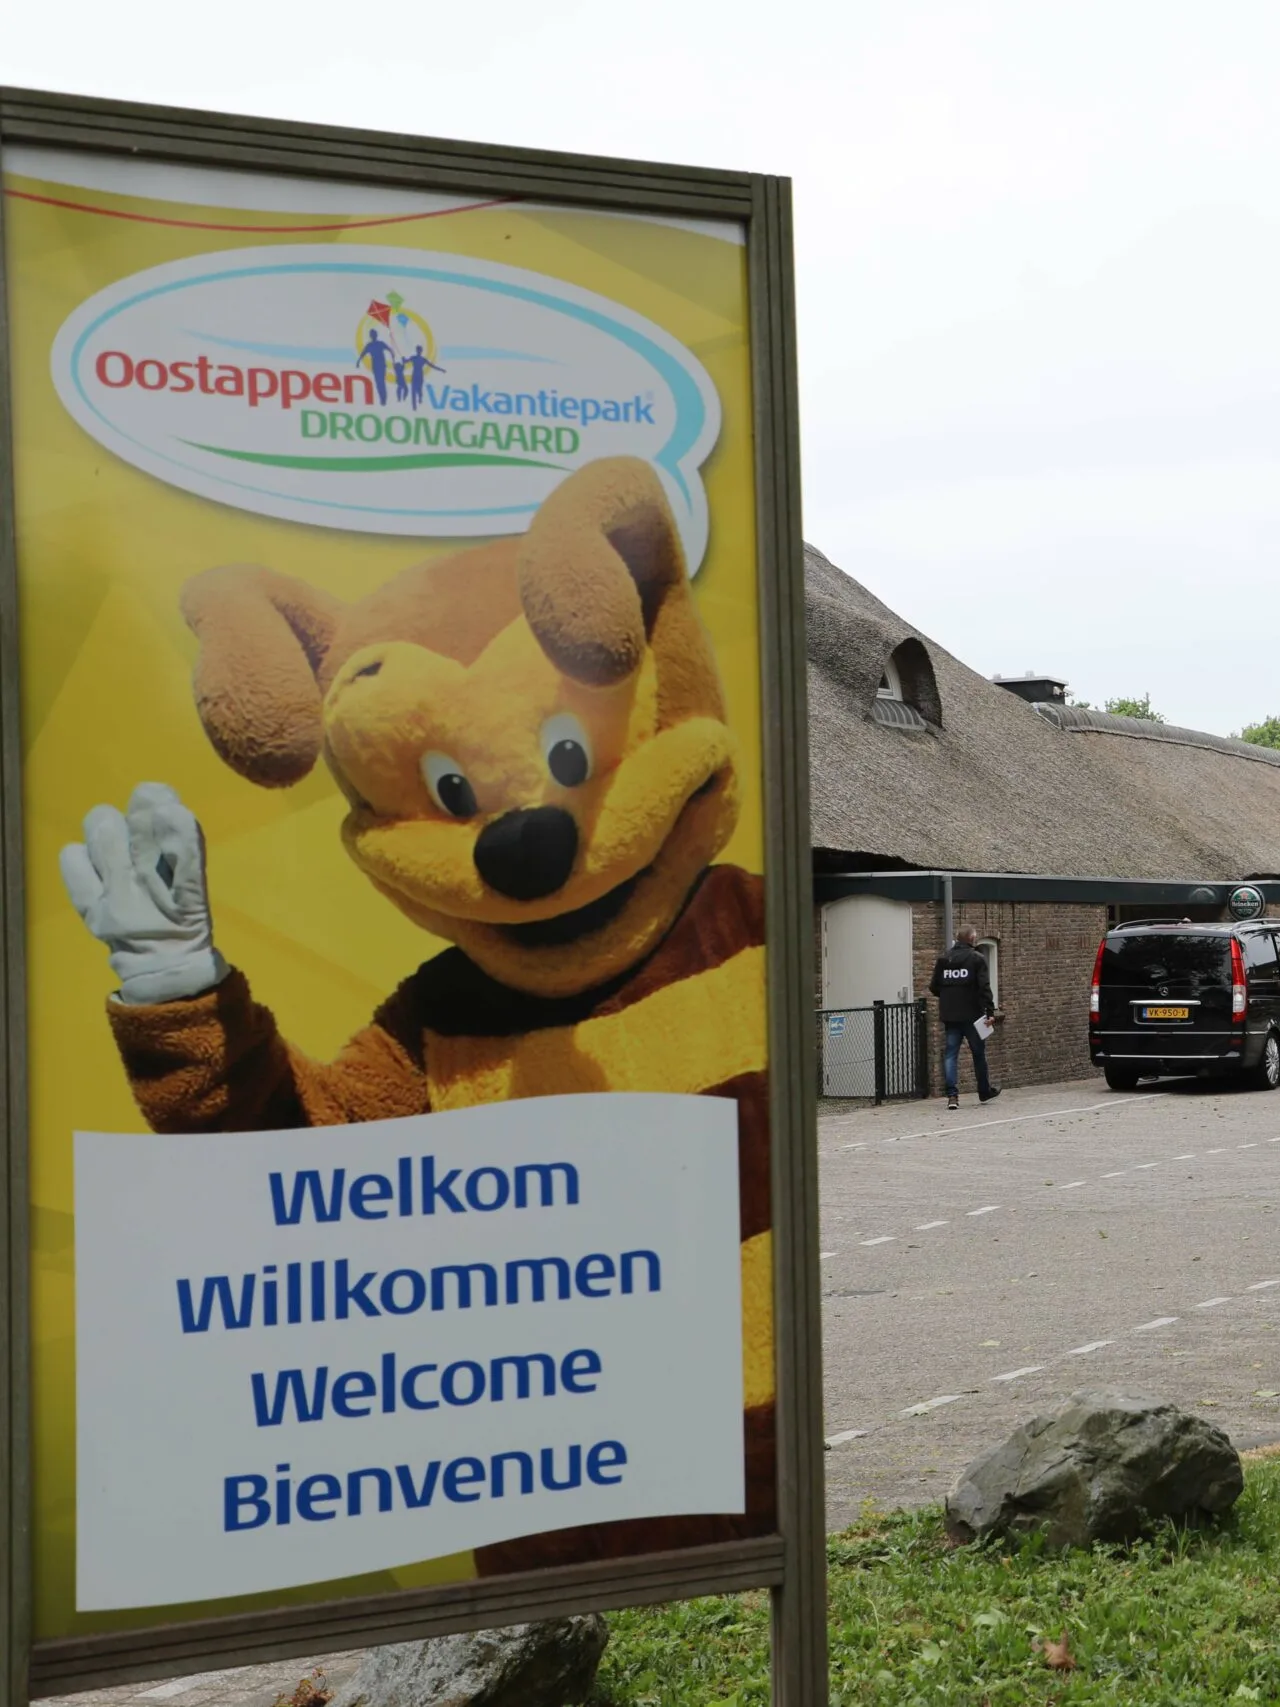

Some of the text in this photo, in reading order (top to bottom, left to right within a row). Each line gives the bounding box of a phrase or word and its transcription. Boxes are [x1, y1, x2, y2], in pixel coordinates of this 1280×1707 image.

[95, 351, 656, 427] Oostappen Vakantiepark
[300, 408, 580, 454] DROOMGAARD
[943, 968, 969, 979] FIOD
[1148, 1008, 1187, 1017] VK-950-X
[269, 1155, 580, 1227] Welkom
[176, 1249, 662, 1334] Willkommen
[251, 1348, 602, 1428] Welcome
[223, 1439, 628, 1532] Bienvenue
